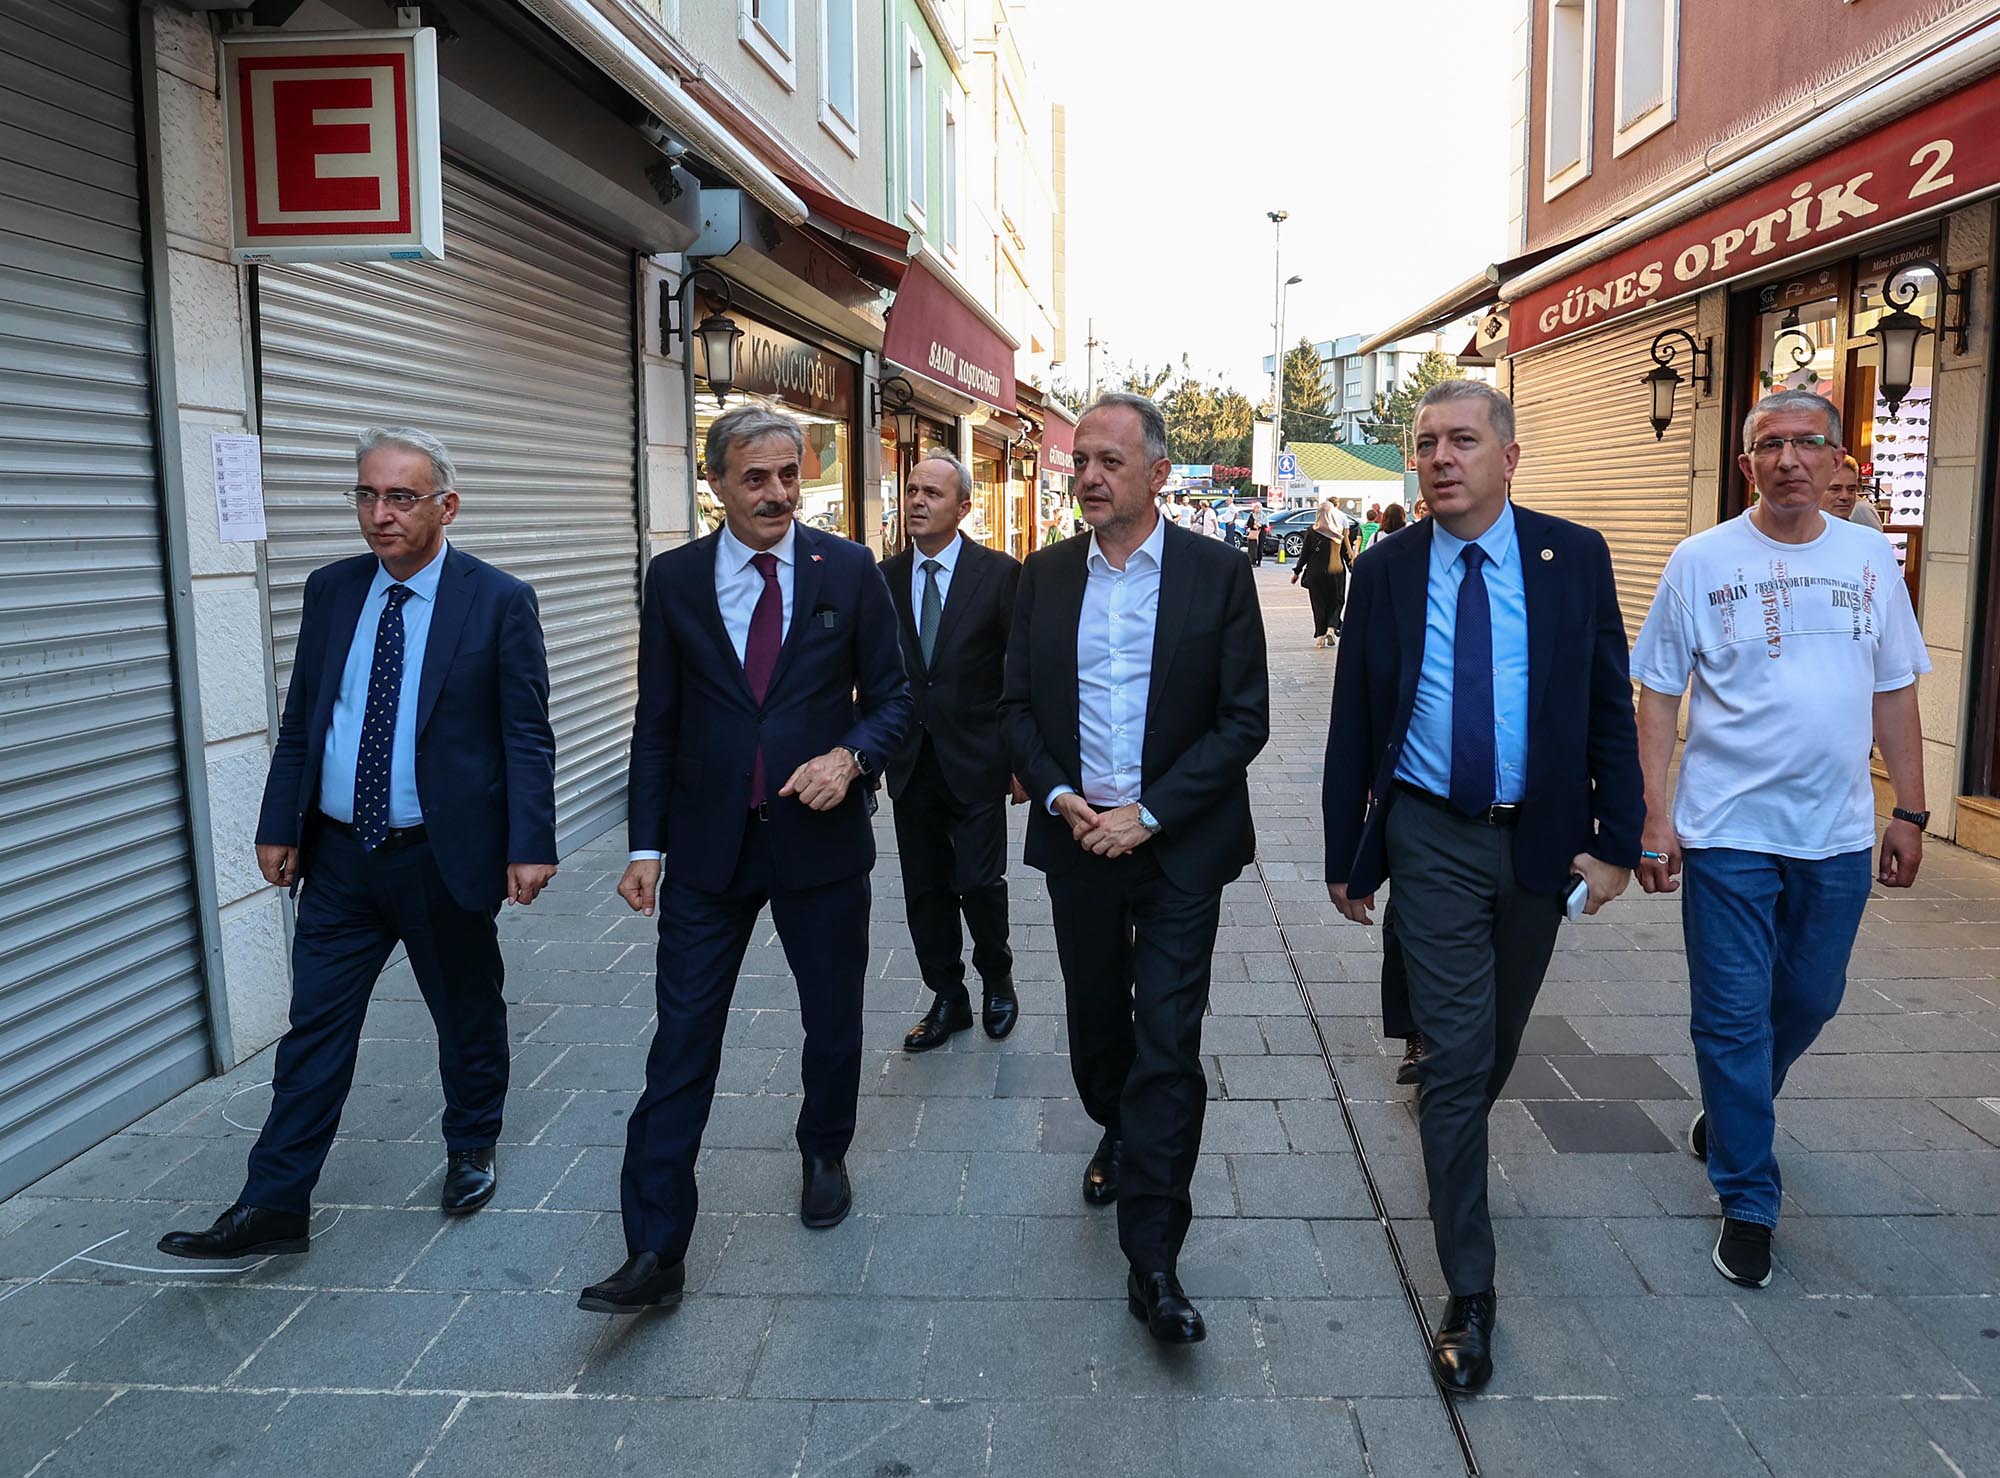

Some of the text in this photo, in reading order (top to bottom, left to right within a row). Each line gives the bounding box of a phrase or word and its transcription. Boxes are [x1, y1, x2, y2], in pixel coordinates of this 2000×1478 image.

[272, 78, 381, 212] E
[1673, 172, 1880, 282] OPTİK
[1907, 138, 1955, 200] 2
[751, 333, 836, 402] KOŞUCUOĞLU
[928, 341, 1001, 398] SADIK KOŞUCUOĞLU
[1708, 584, 1748, 607] BRAIN
